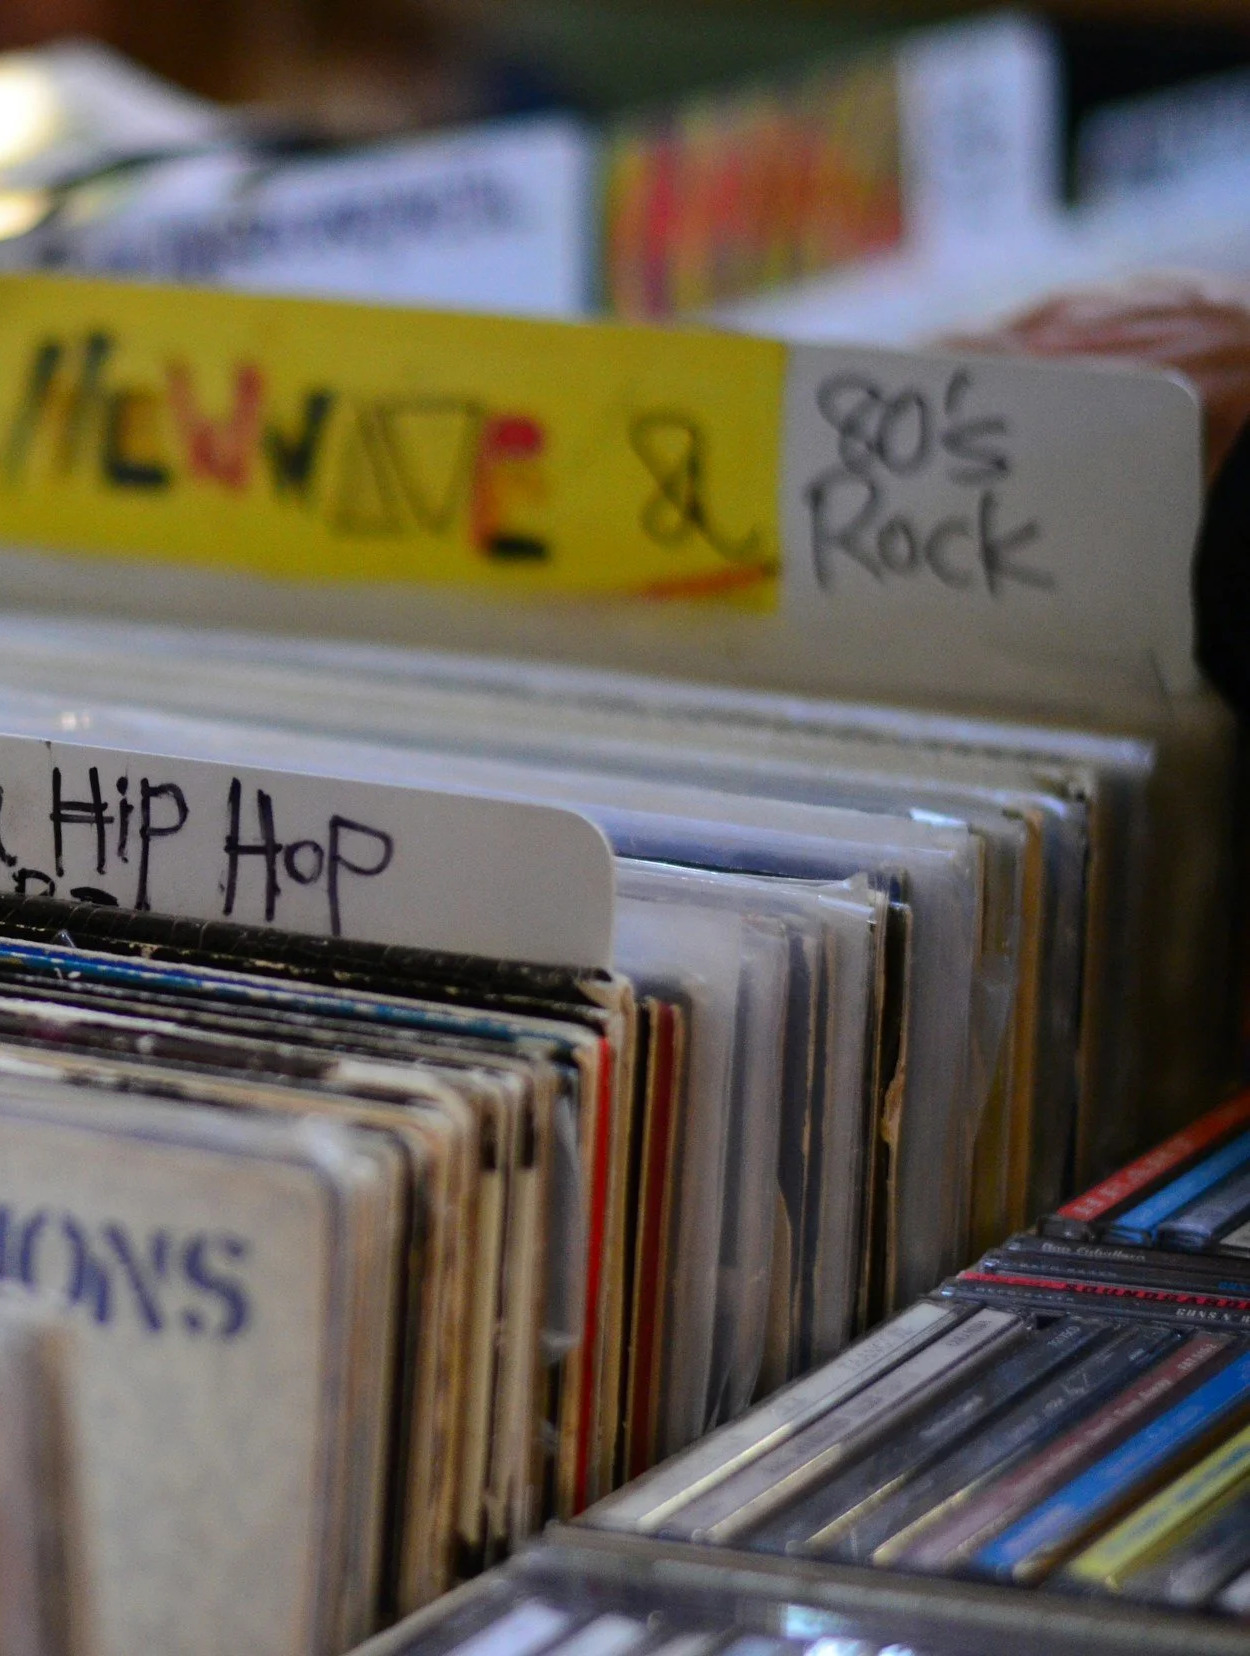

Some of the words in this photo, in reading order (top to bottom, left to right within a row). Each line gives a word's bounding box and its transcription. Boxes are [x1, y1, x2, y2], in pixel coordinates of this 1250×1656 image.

[628, 408, 764, 566] &
[814, 366, 1012, 488] 80's
[802, 464, 1060, 598] Rock
[49, 766, 189, 911] HiP
